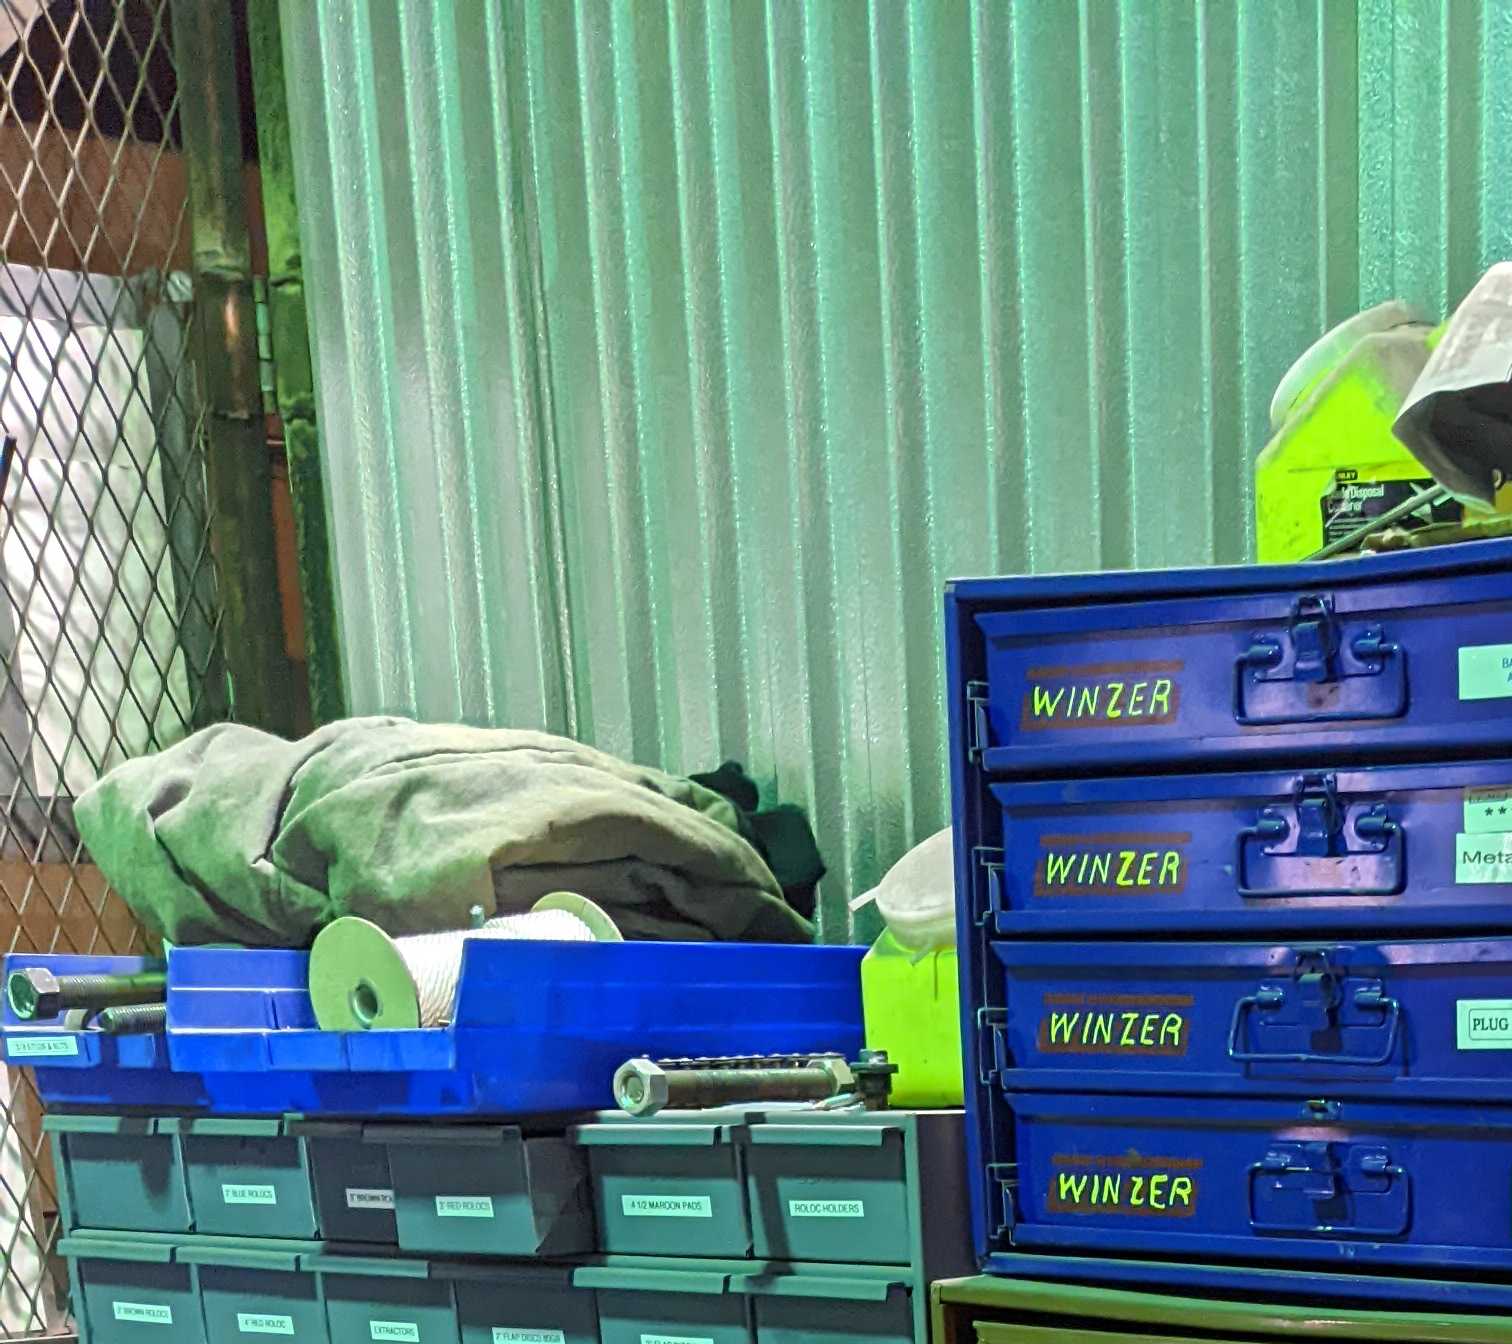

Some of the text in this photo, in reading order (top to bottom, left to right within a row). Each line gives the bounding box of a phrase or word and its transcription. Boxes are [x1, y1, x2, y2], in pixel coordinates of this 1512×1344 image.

[1033, 679, 1172, 719] WINZER
[1046, 851, 1180, 886] WINZER
[1050, 1012, 1183, 1046] WINZER
[1473, 1018, 1508, 1031] PLUG
[1058, 1172, 1193, 1209] WINZER
